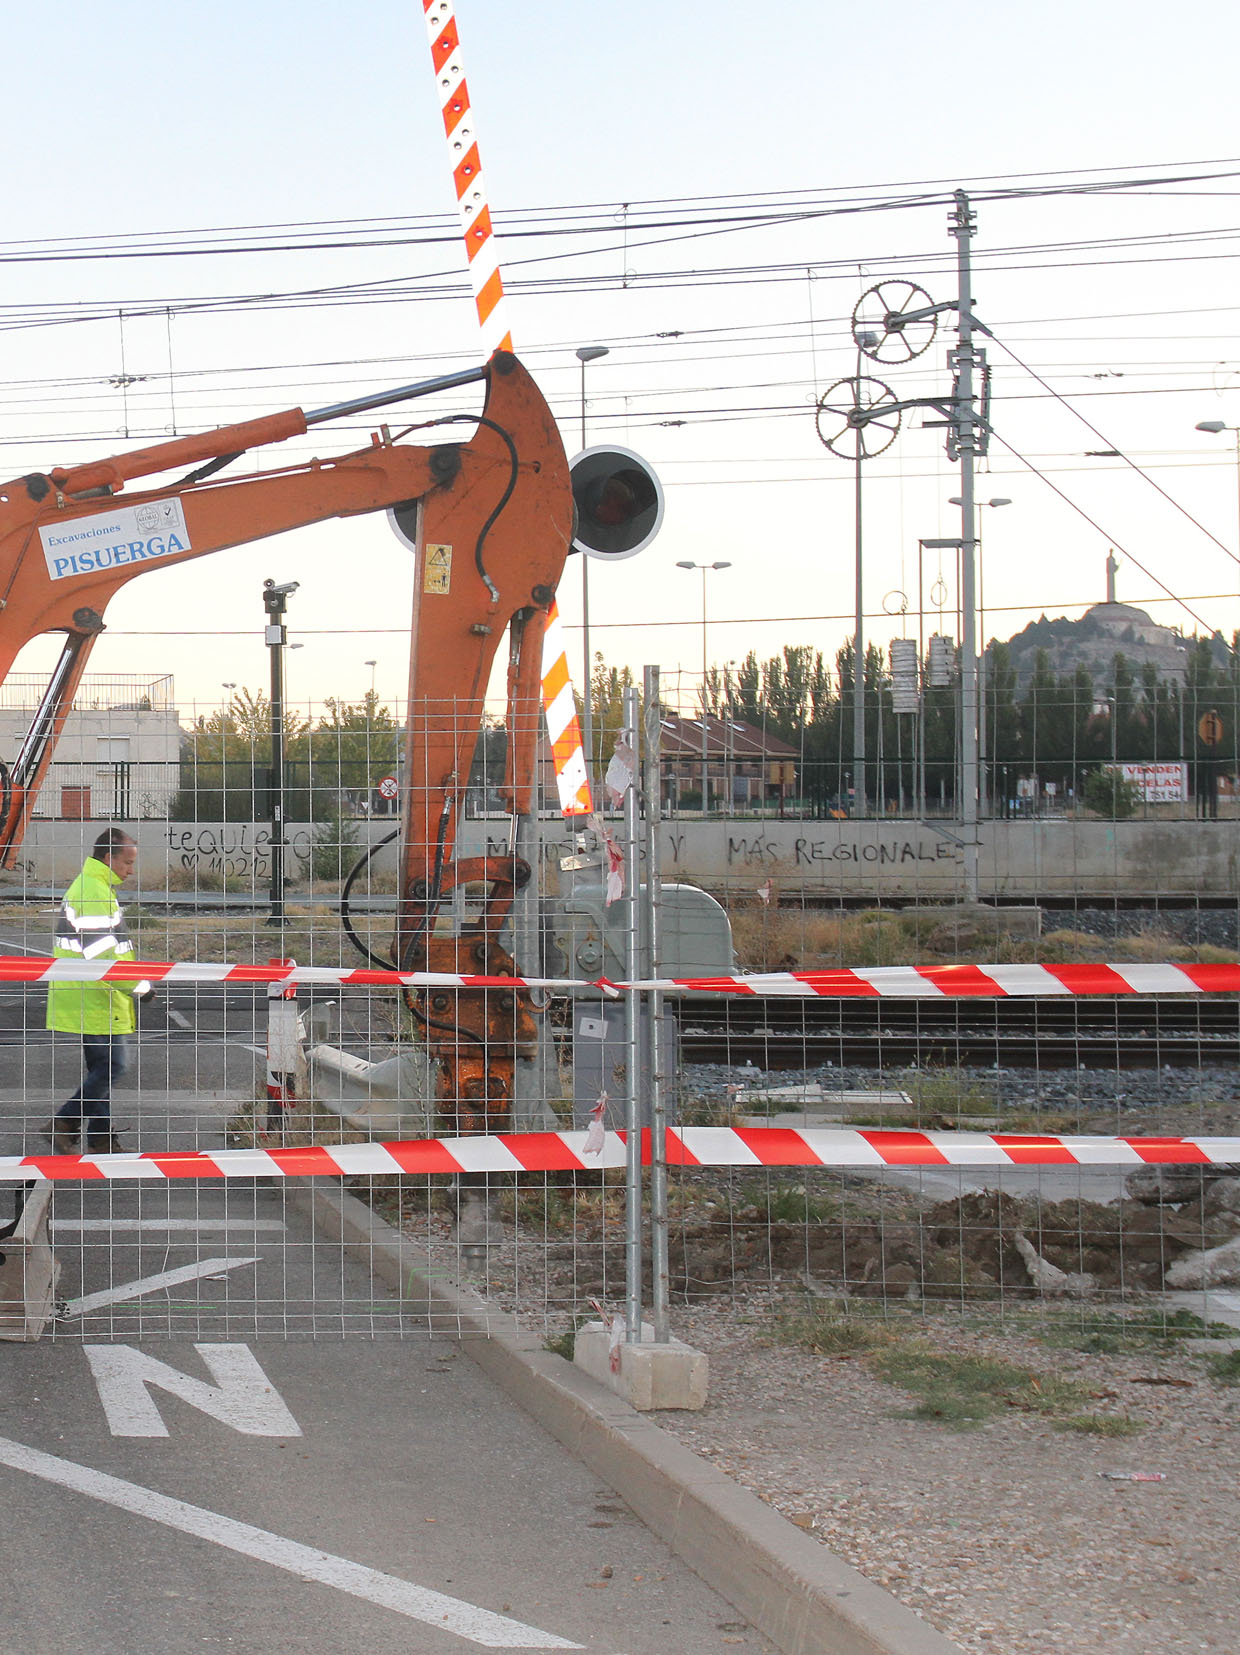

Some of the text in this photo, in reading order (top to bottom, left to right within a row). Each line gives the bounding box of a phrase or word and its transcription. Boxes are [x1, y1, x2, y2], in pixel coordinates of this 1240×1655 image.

[48, 524, 121, 547] Excavaciones
[53, 533, 185, 577] PISUERGA
[1127, 765, 1183, 775] VENDEN
[81, 1340, 304, 1440] N
